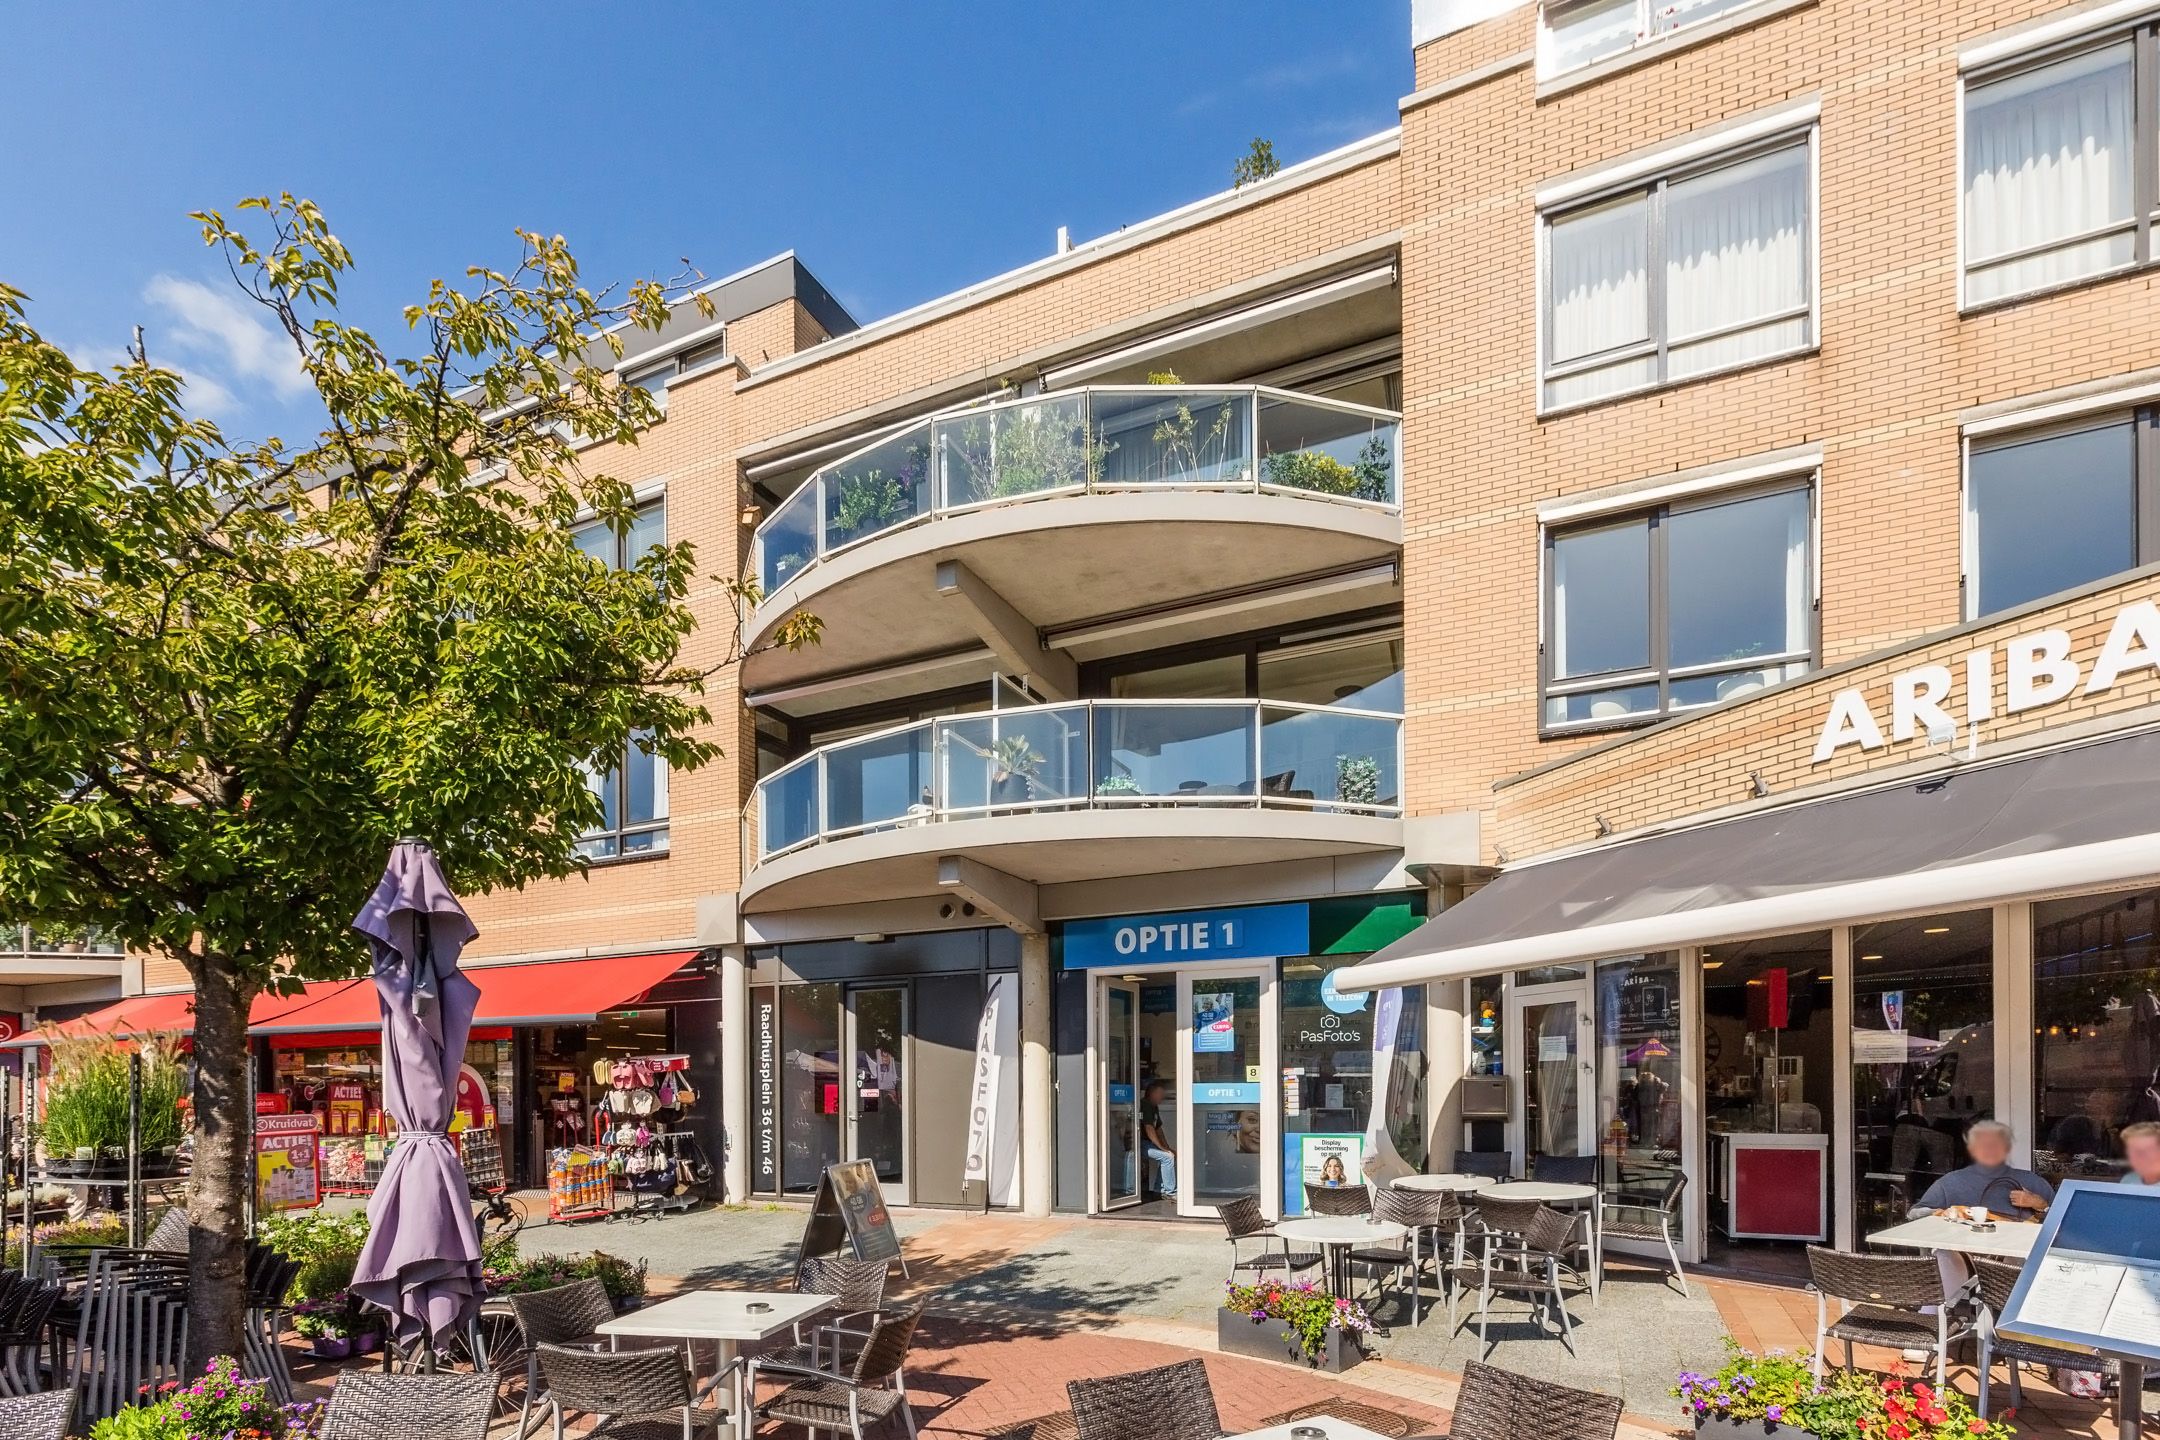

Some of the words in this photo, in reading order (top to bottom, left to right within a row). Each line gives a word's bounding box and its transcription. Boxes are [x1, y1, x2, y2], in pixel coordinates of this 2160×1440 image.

[1811, 599, 2160, 764] ARIBA
[1114, 922, 1209, 954] OPTIE
[1222, 922, 1233, 946] 1
[1335, 994, 1363, 1002] TELECOM
[1300, 1030, 1361, 1041] PasFoto's
[760, 1004, 773, 1105] Raadhuisplein
[1250, 1069, 1257, 1077] 8
[334, 1085, 363, 1099] ACTIE!
[1208, 1089, 1235, 1097] OPTIE
[1236, 1089, 1241, 1097] 1
[268, 1117, 313, 1129] Kruidvat
[761, 1108, 773, 1126] 36
[262, 1135, 313, 1149] ACTIE!
[761, 1128, 773, 1154] t/m
[291, 1149, 310, 1159] 1+1
[762, 1157, 773, 1175] 46
